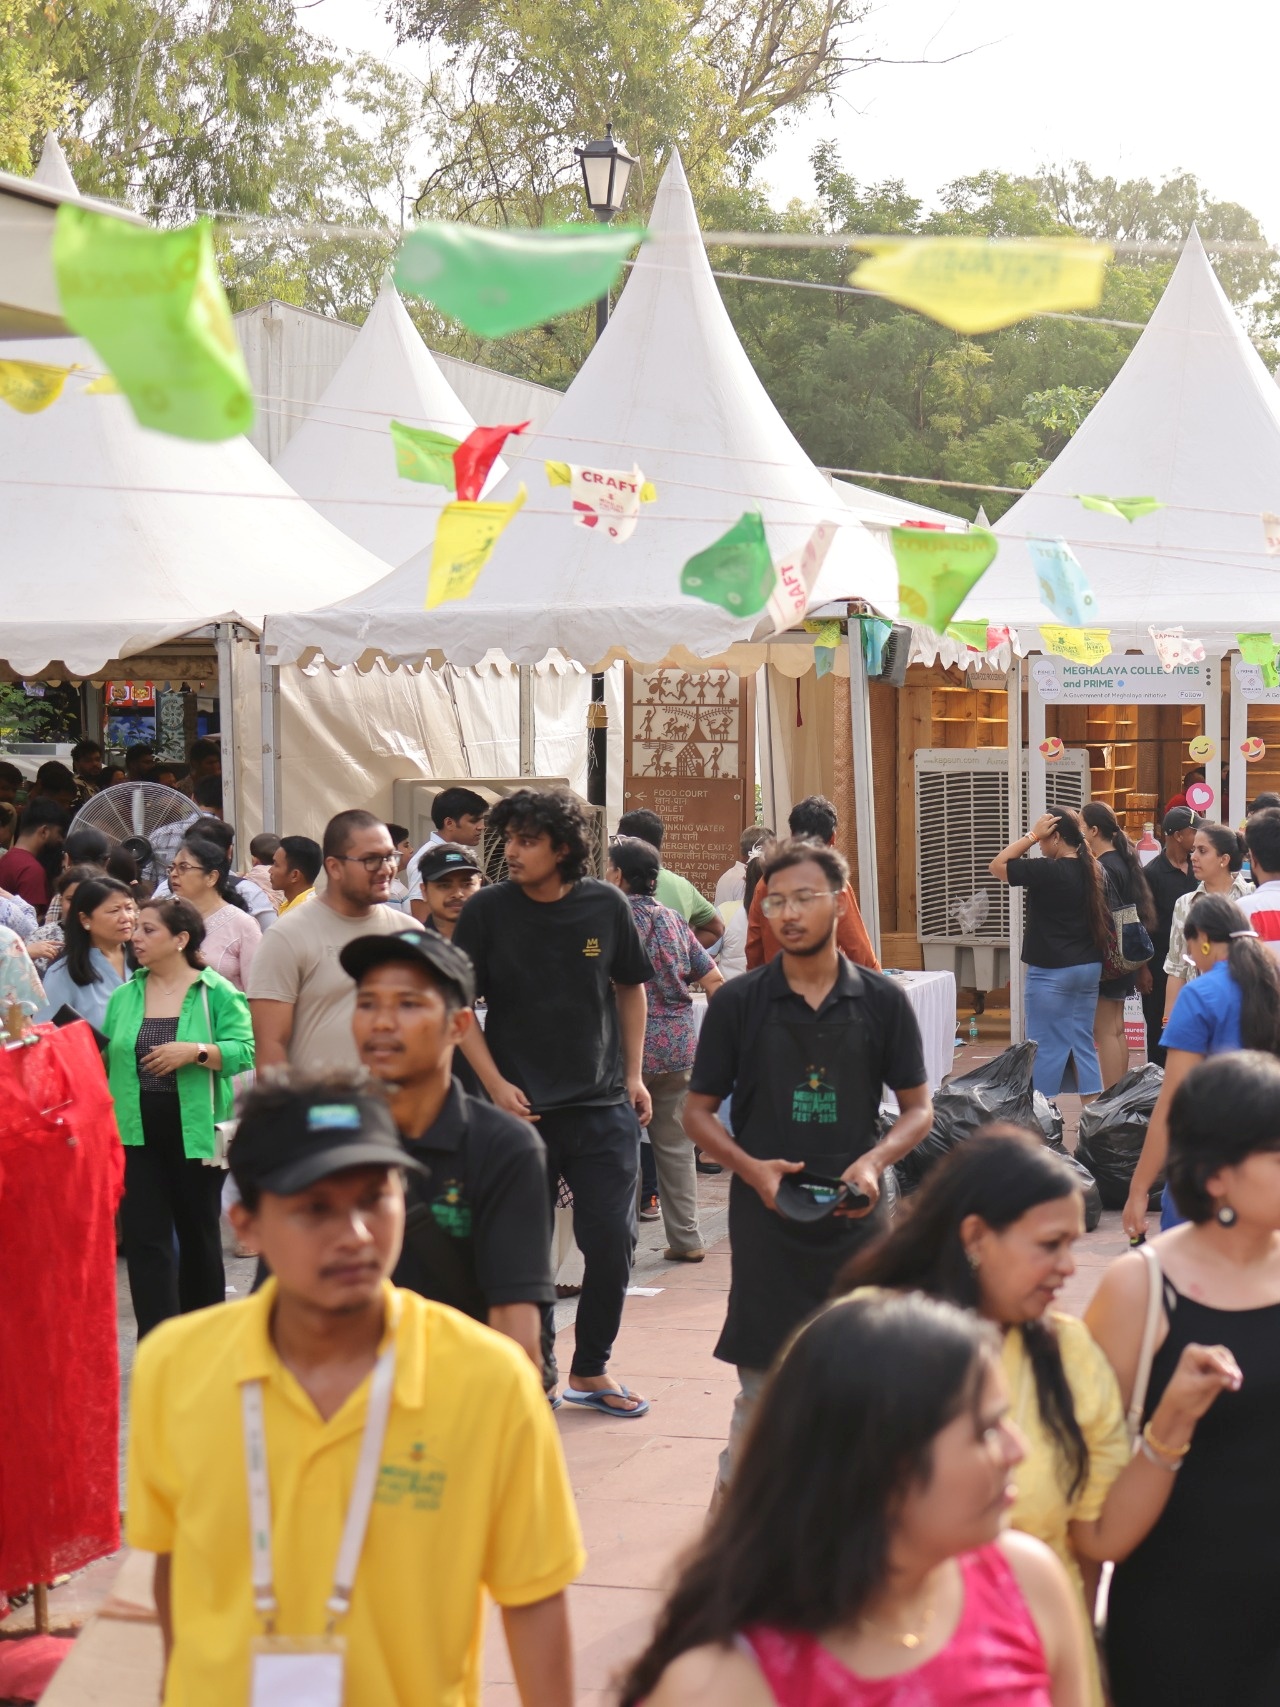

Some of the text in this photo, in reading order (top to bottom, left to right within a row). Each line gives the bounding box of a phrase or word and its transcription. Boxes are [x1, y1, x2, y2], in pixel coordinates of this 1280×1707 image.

[581, 471, 638, 493] CRAFT
[781, 565, 806, 610] RAFT
[1063, 666, 1200, 675] MEGHALAYA COLLETIVES
[1063, 679, 1114, 688] and PRIME
[661, 842, 733, 851] MERGENCY EXIT-2
[660, 850, 701, 860] पातकालीन
[674, 862, 696, 870] PLAY
[697, 863, 720, 871] ZONE
